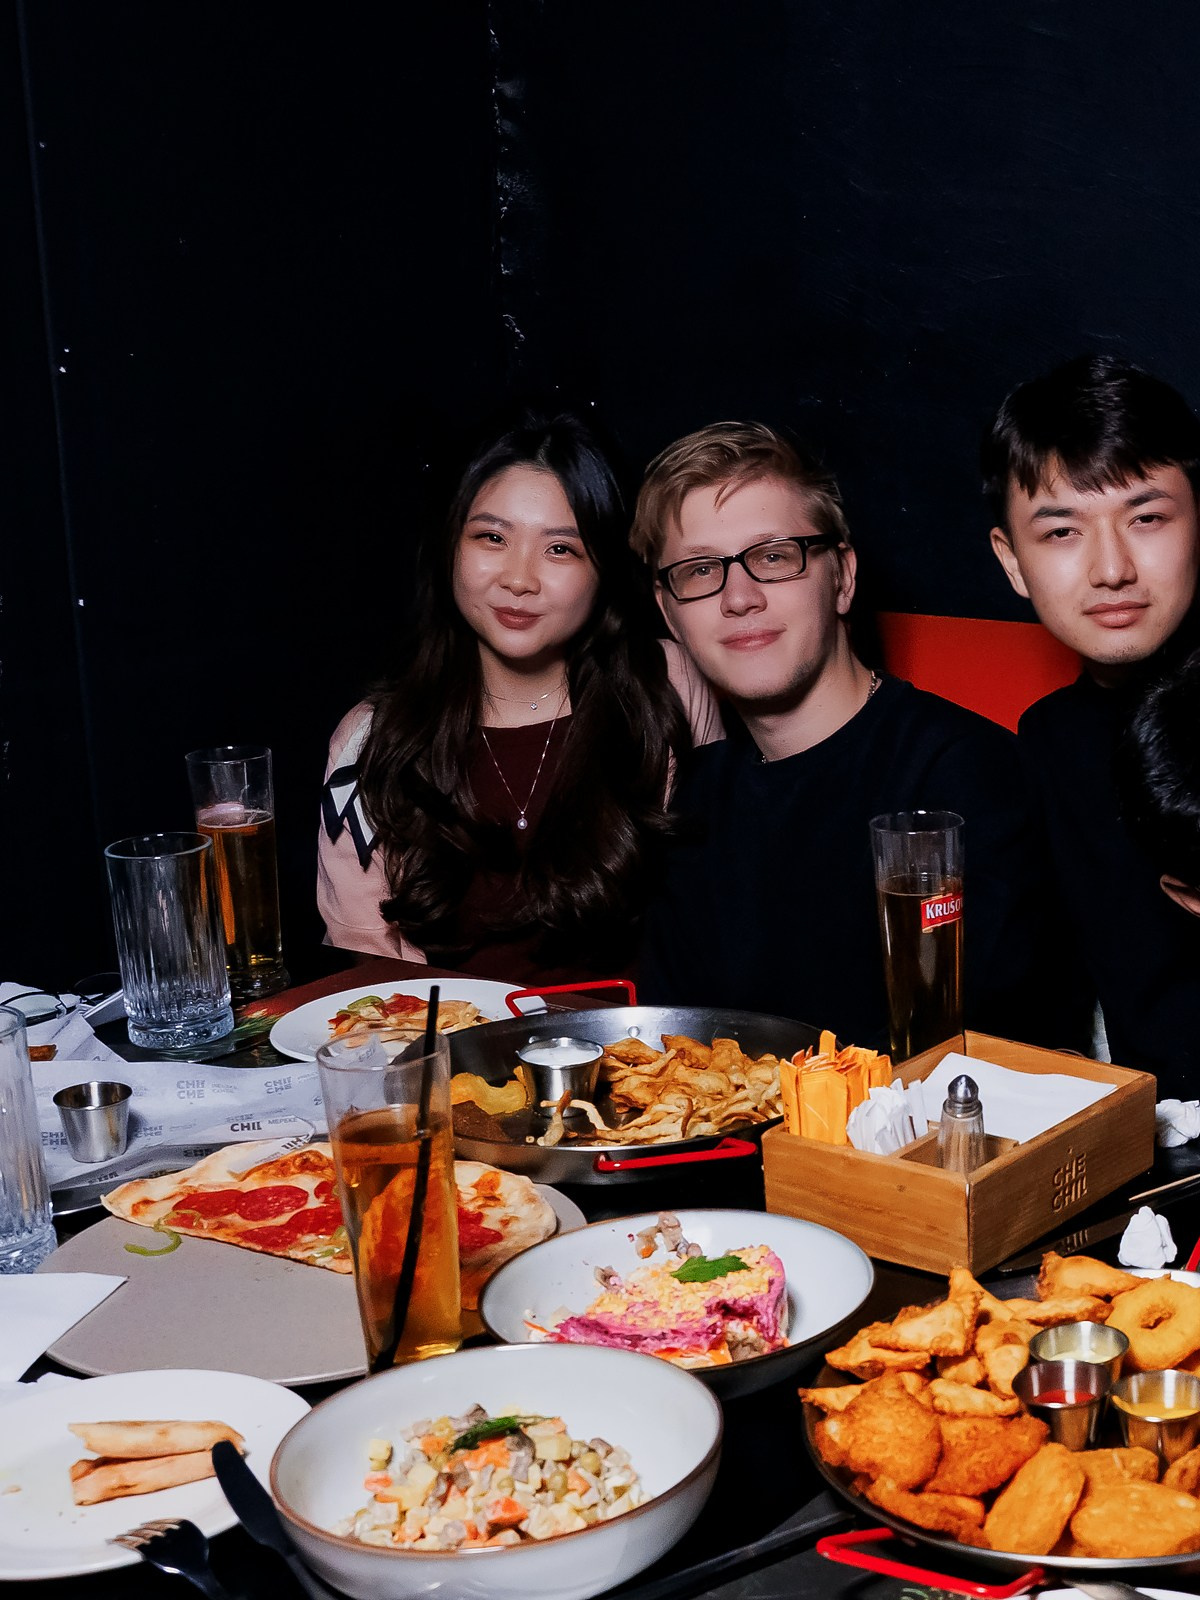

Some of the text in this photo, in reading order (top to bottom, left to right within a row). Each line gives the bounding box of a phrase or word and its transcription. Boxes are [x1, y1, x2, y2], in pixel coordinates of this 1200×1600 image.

[926, 898, 962, 919] KRUŠO
[1053, 1153, 1087, 1189] CHE
[1052, 1175, 1088, 1213] CHIL
